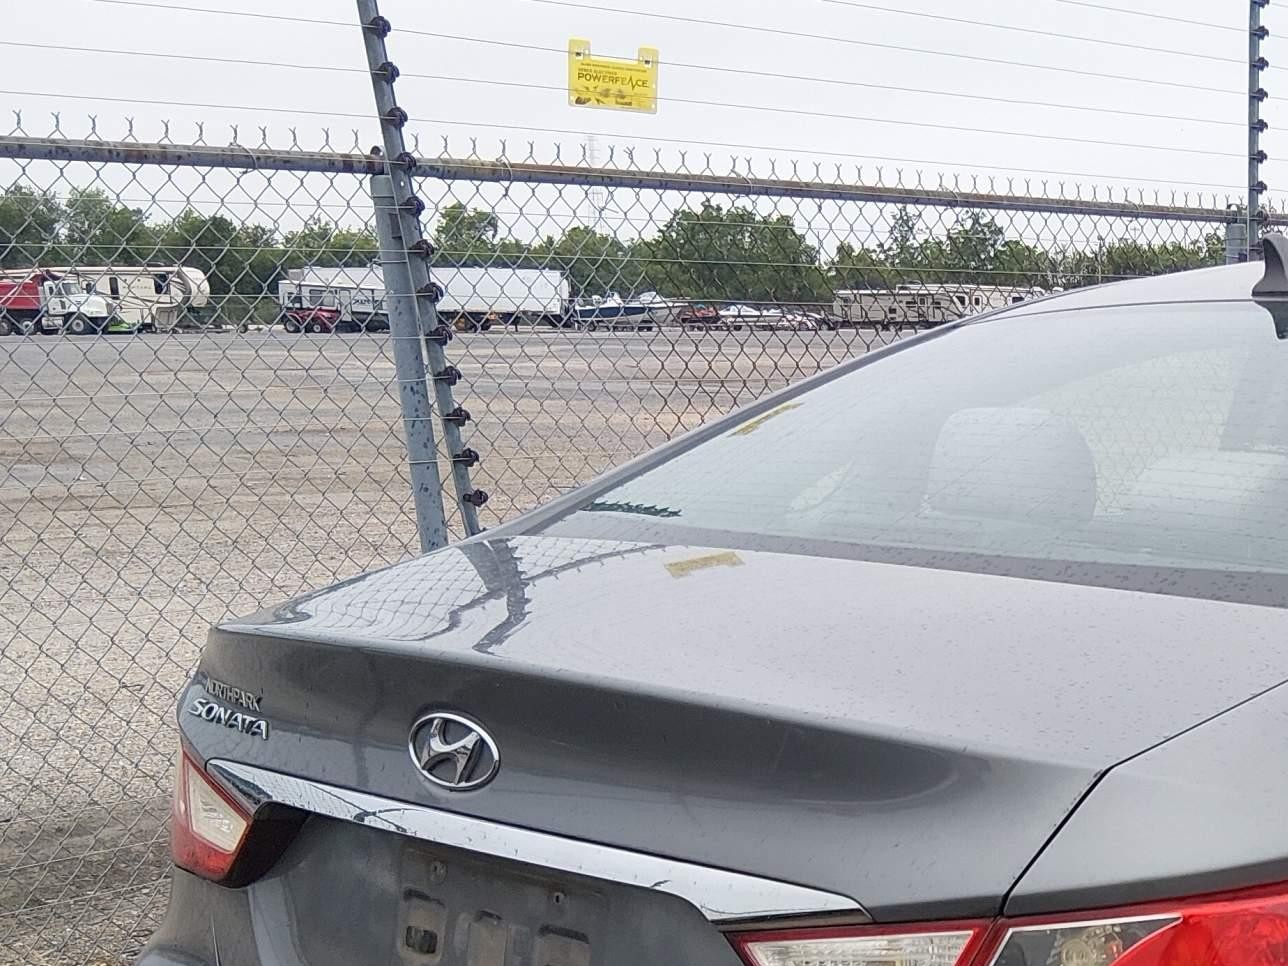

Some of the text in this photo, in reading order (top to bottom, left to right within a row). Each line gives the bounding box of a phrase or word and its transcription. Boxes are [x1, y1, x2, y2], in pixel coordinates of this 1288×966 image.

[577, 72, 649, 90] POWERFENCE
[205, 677, 263, 713] NORTHPARK
[187, 698, 269, 740] SONATA
